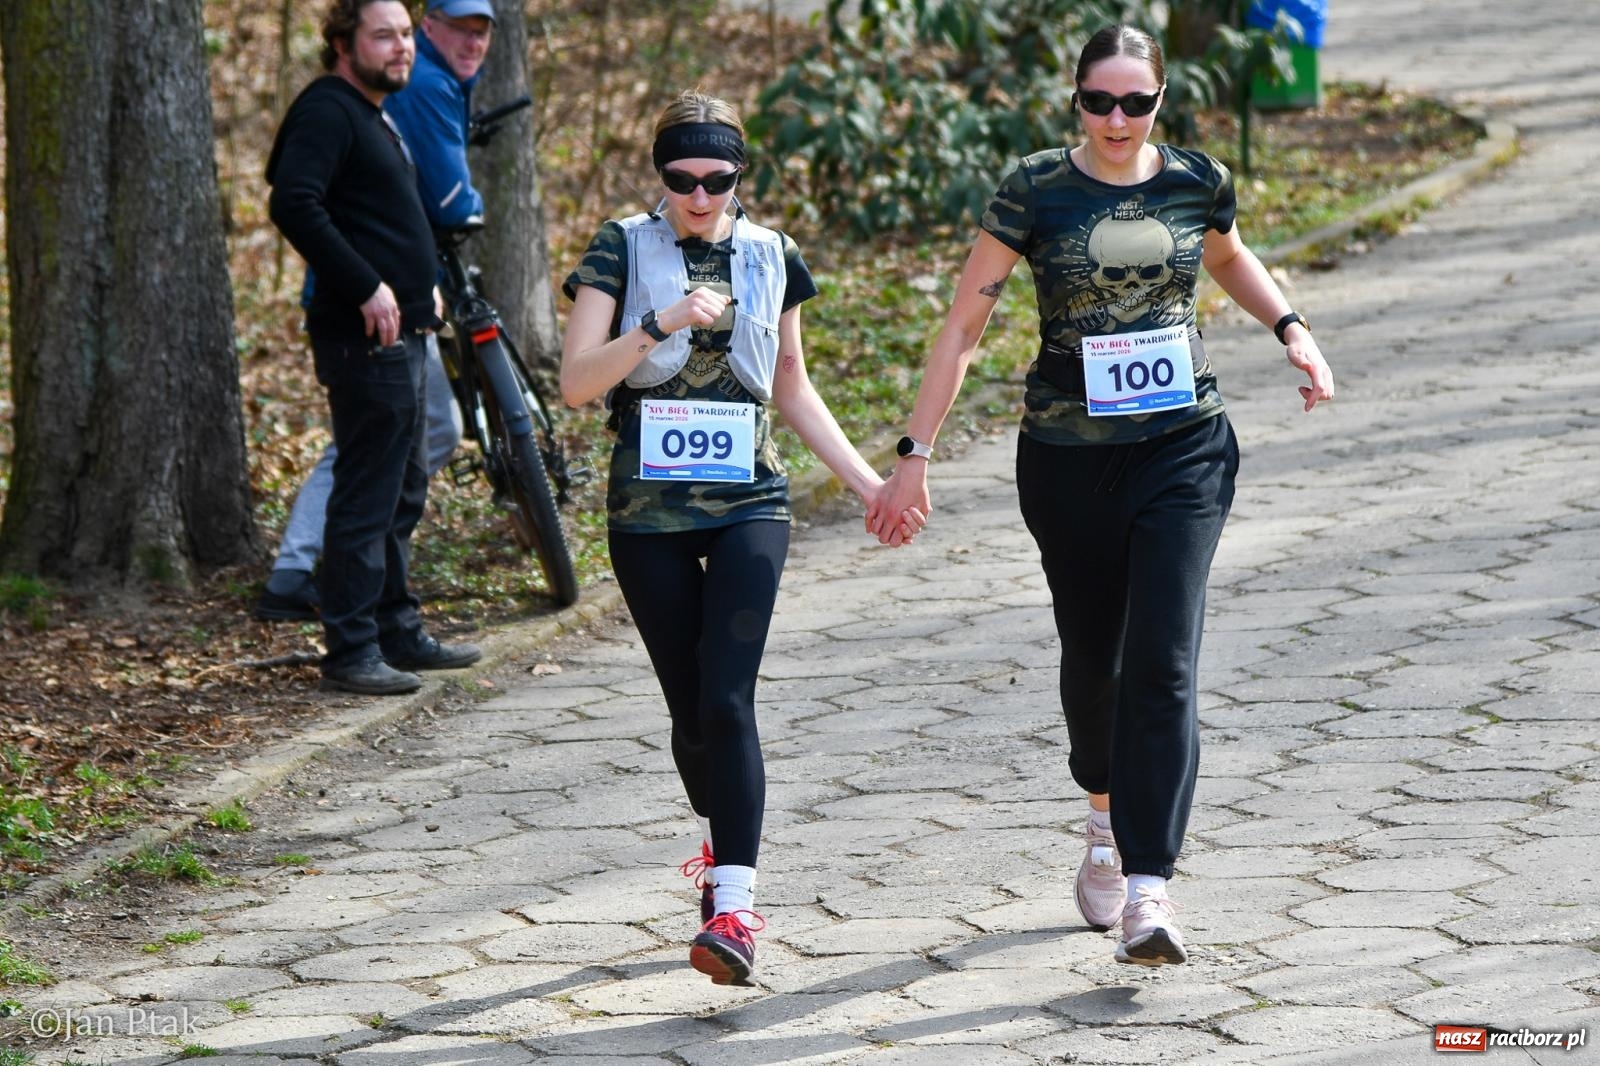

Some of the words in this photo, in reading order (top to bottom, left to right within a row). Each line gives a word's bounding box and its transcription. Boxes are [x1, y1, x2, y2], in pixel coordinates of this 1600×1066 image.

[1116, 201, 1138, 210] JUST
[1115, 210, 1144, 220] HERO
[691, 274, 720, 282] HERO
[1090, 342, 1106, 350] XIV
[1109, 339, 1130, 349] BIEG
[1108, 357, 1174, 392] 100
[649, 406, 665, 414] XIV
[668, 406, 689, 415] BIEG
[661, 429, 733, 459] 099
